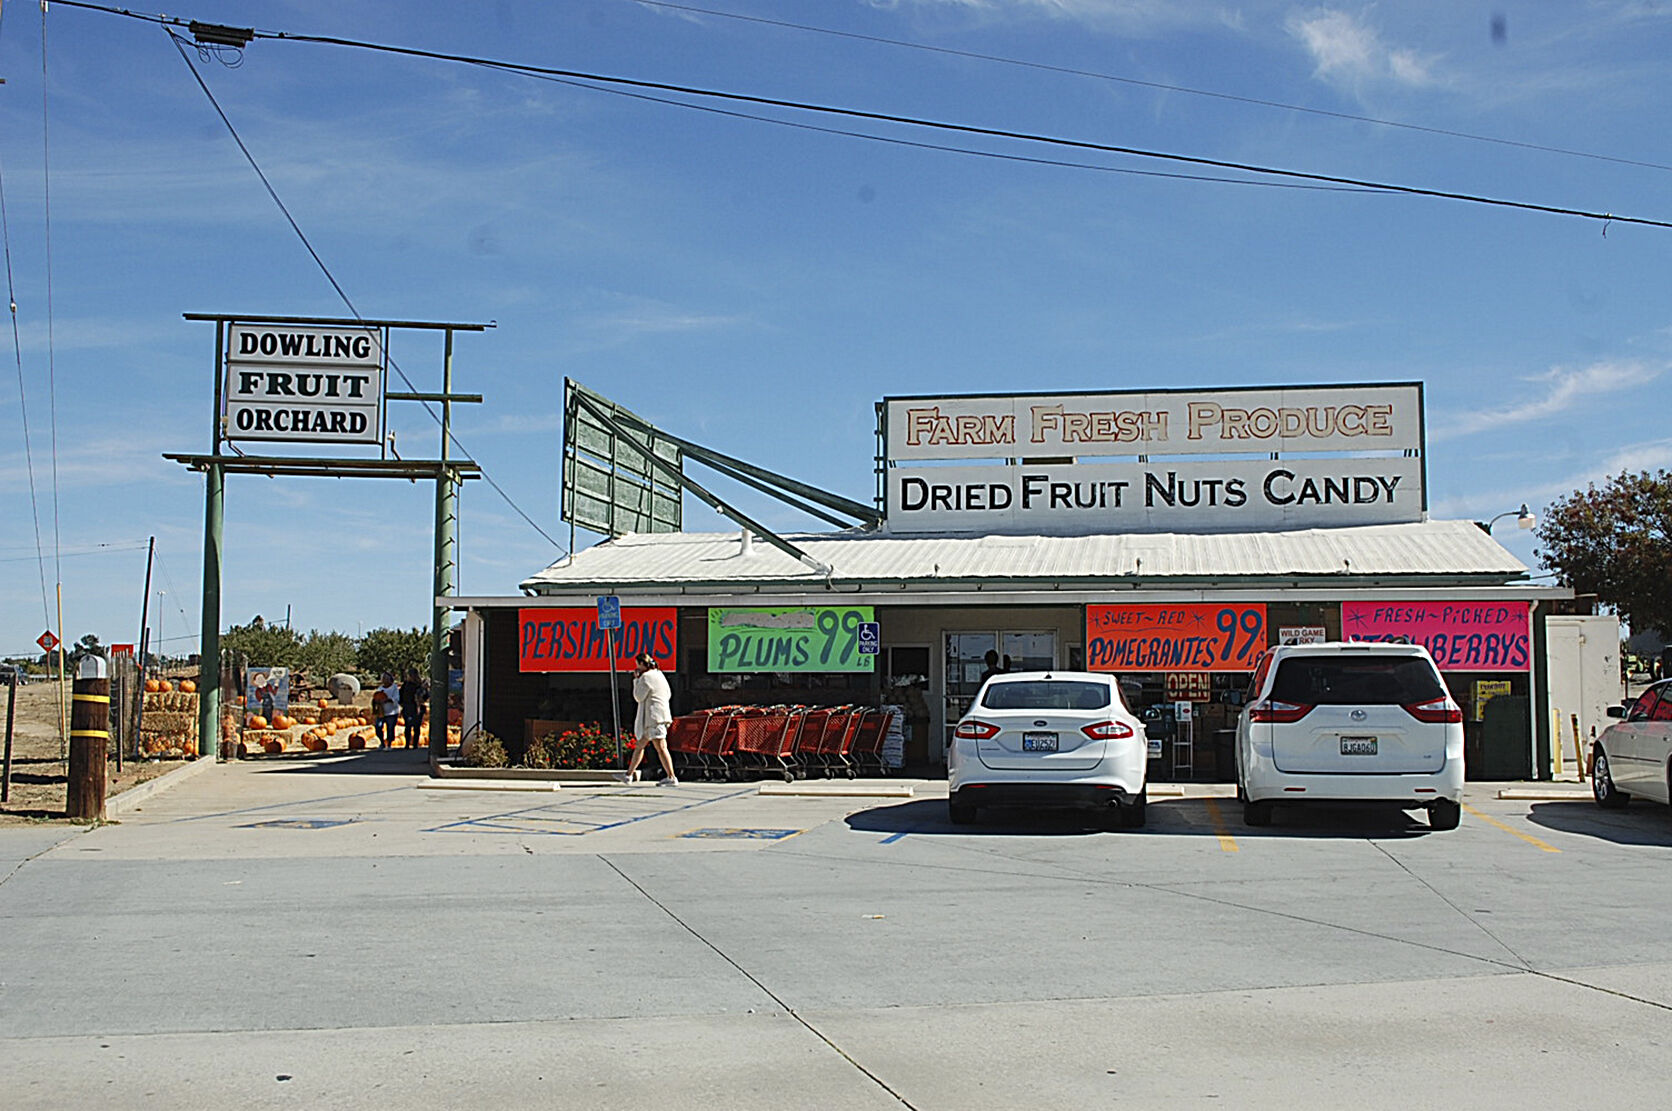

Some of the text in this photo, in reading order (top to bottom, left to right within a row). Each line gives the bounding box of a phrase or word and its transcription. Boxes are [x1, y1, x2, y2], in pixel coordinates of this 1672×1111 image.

[240, 332, 371, 359] DOWLING
[238, 371, 369, 398] FRUIT
[236, 408, 367, 435] ORCHARD
[906, 401, 1393, 446] FARM FRESH PRODUCE
[900, 469, 1403, 511] DRIED FRUIT NUTS CANDY
[1280, 629, 1324, 637] WILD GAME
[718, 633, 810, 670] PLUMS
[1088, 636, 1219, 667] POMEGRANTES
[1167, 673, 1208, 698] OPEN
